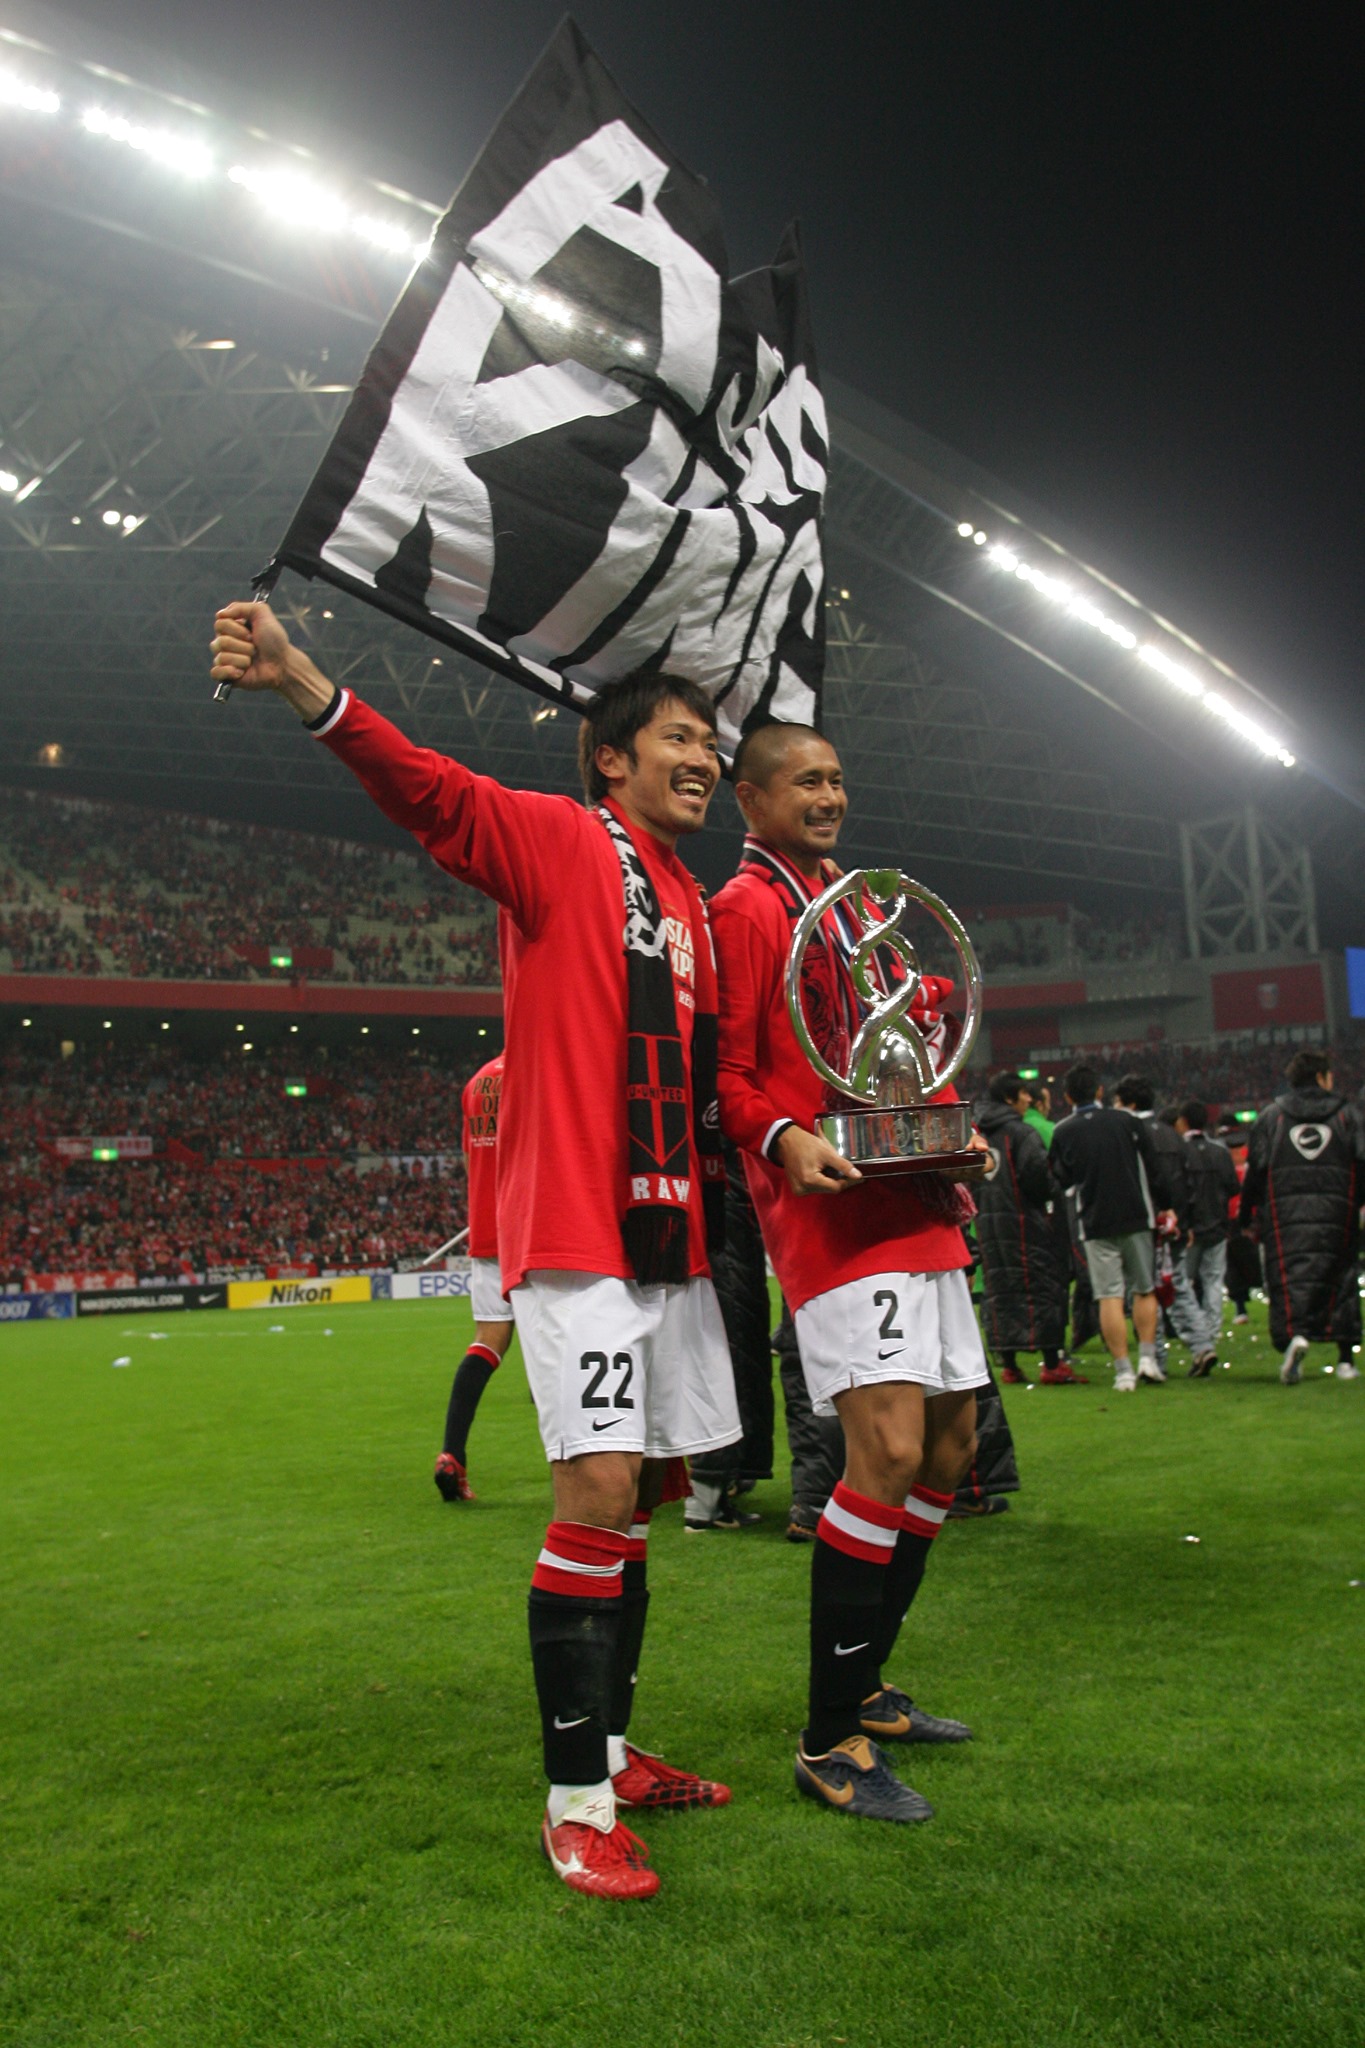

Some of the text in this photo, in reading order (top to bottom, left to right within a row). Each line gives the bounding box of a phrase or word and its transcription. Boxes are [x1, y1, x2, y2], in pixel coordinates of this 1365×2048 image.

[80, 1294, 184, 1312] NIKEFOOTBALL.COM
[270, 1284, 332, 1304] Nikon
[873, 1289, 904, 1339] 2
[580, 1351, 634, 1409] 22
